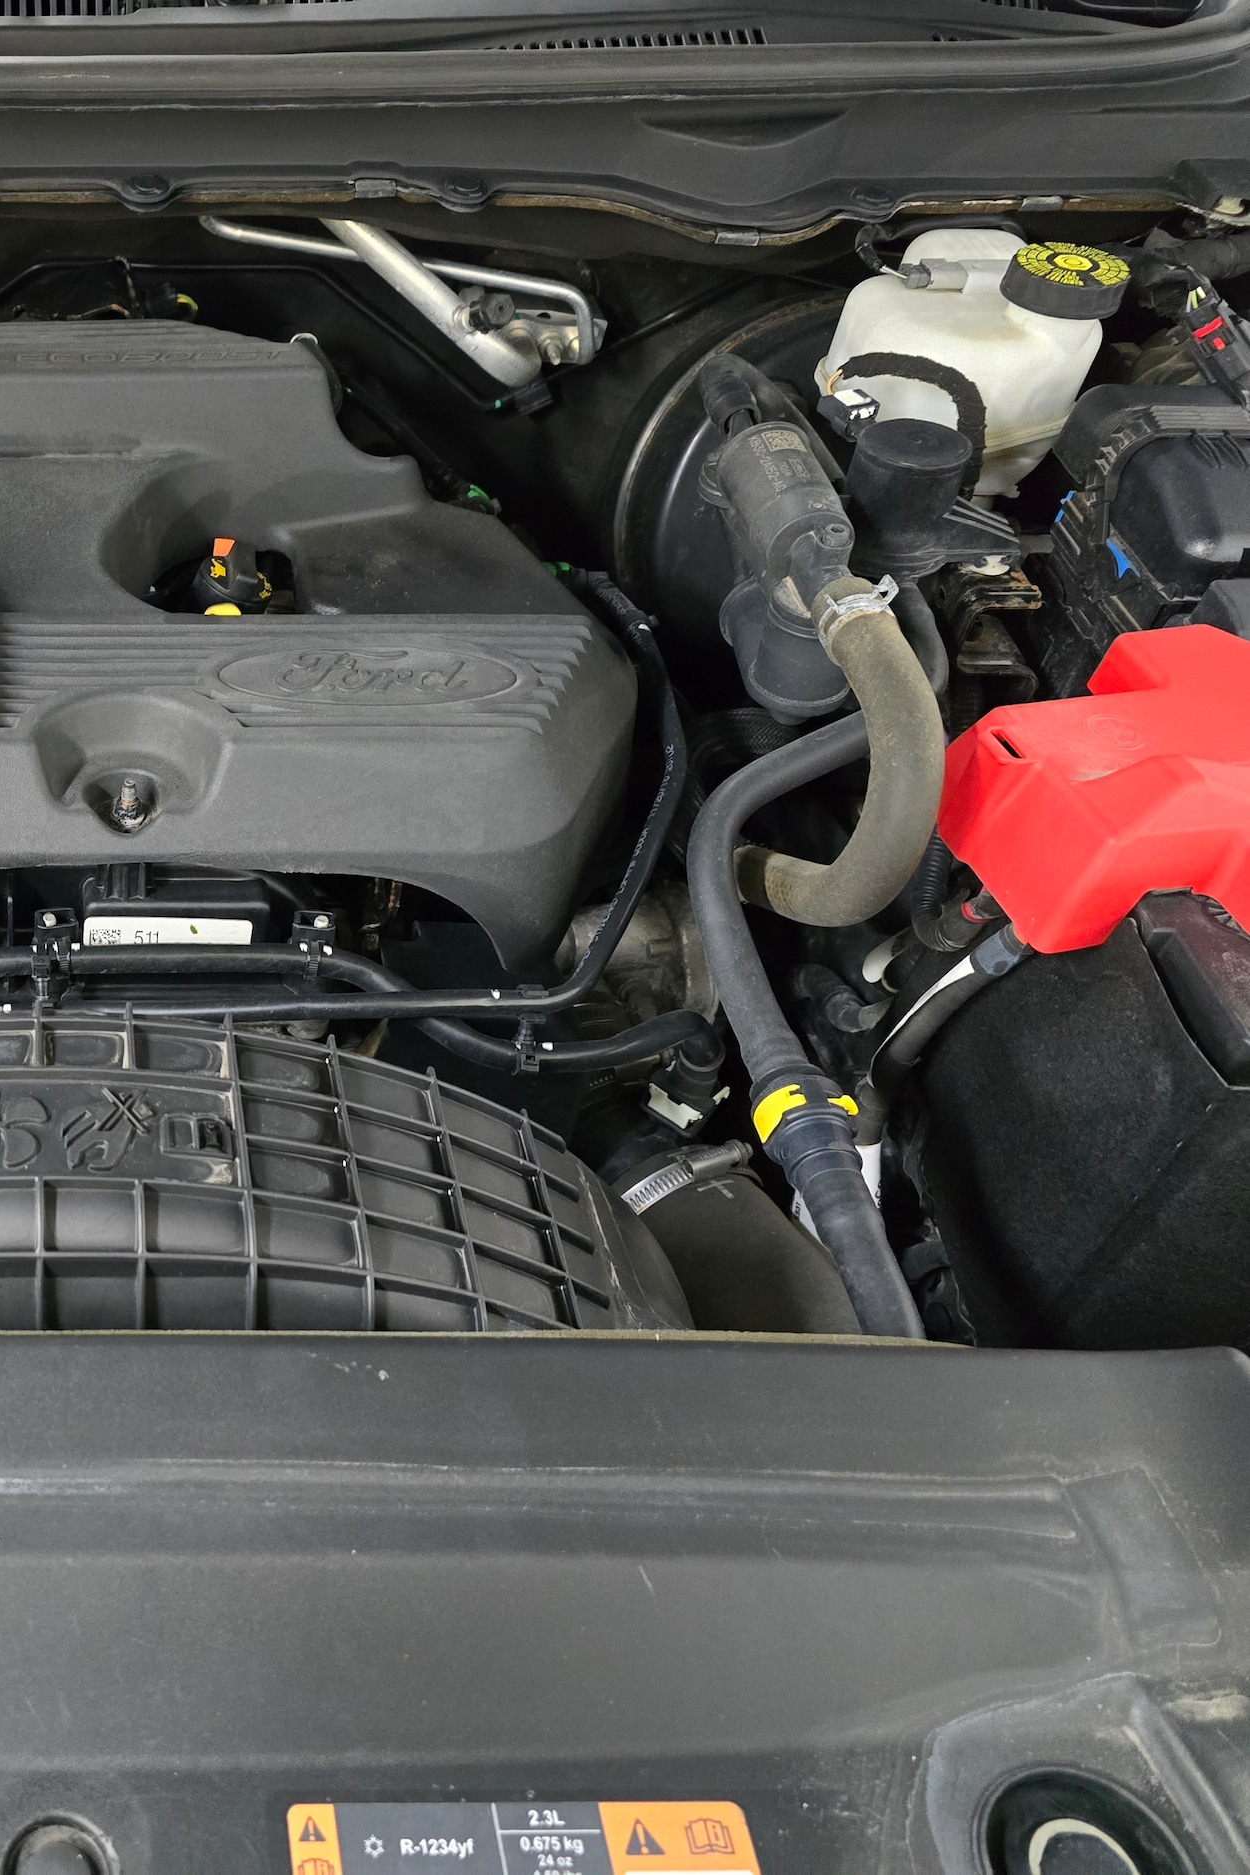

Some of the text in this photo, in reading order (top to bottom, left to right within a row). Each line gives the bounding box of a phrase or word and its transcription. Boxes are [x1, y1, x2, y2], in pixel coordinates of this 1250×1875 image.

[276, 651, 467, 693] Ford
[133, 930, 159, 945] 511
[527, 1809, 567, 1827] 2.3L
[399, 1837, 475, 1860] R-1234yf
[519, 1836, 585, 1855] 0.675 kg
[537, 1853, 574, 1867] 24 oz
